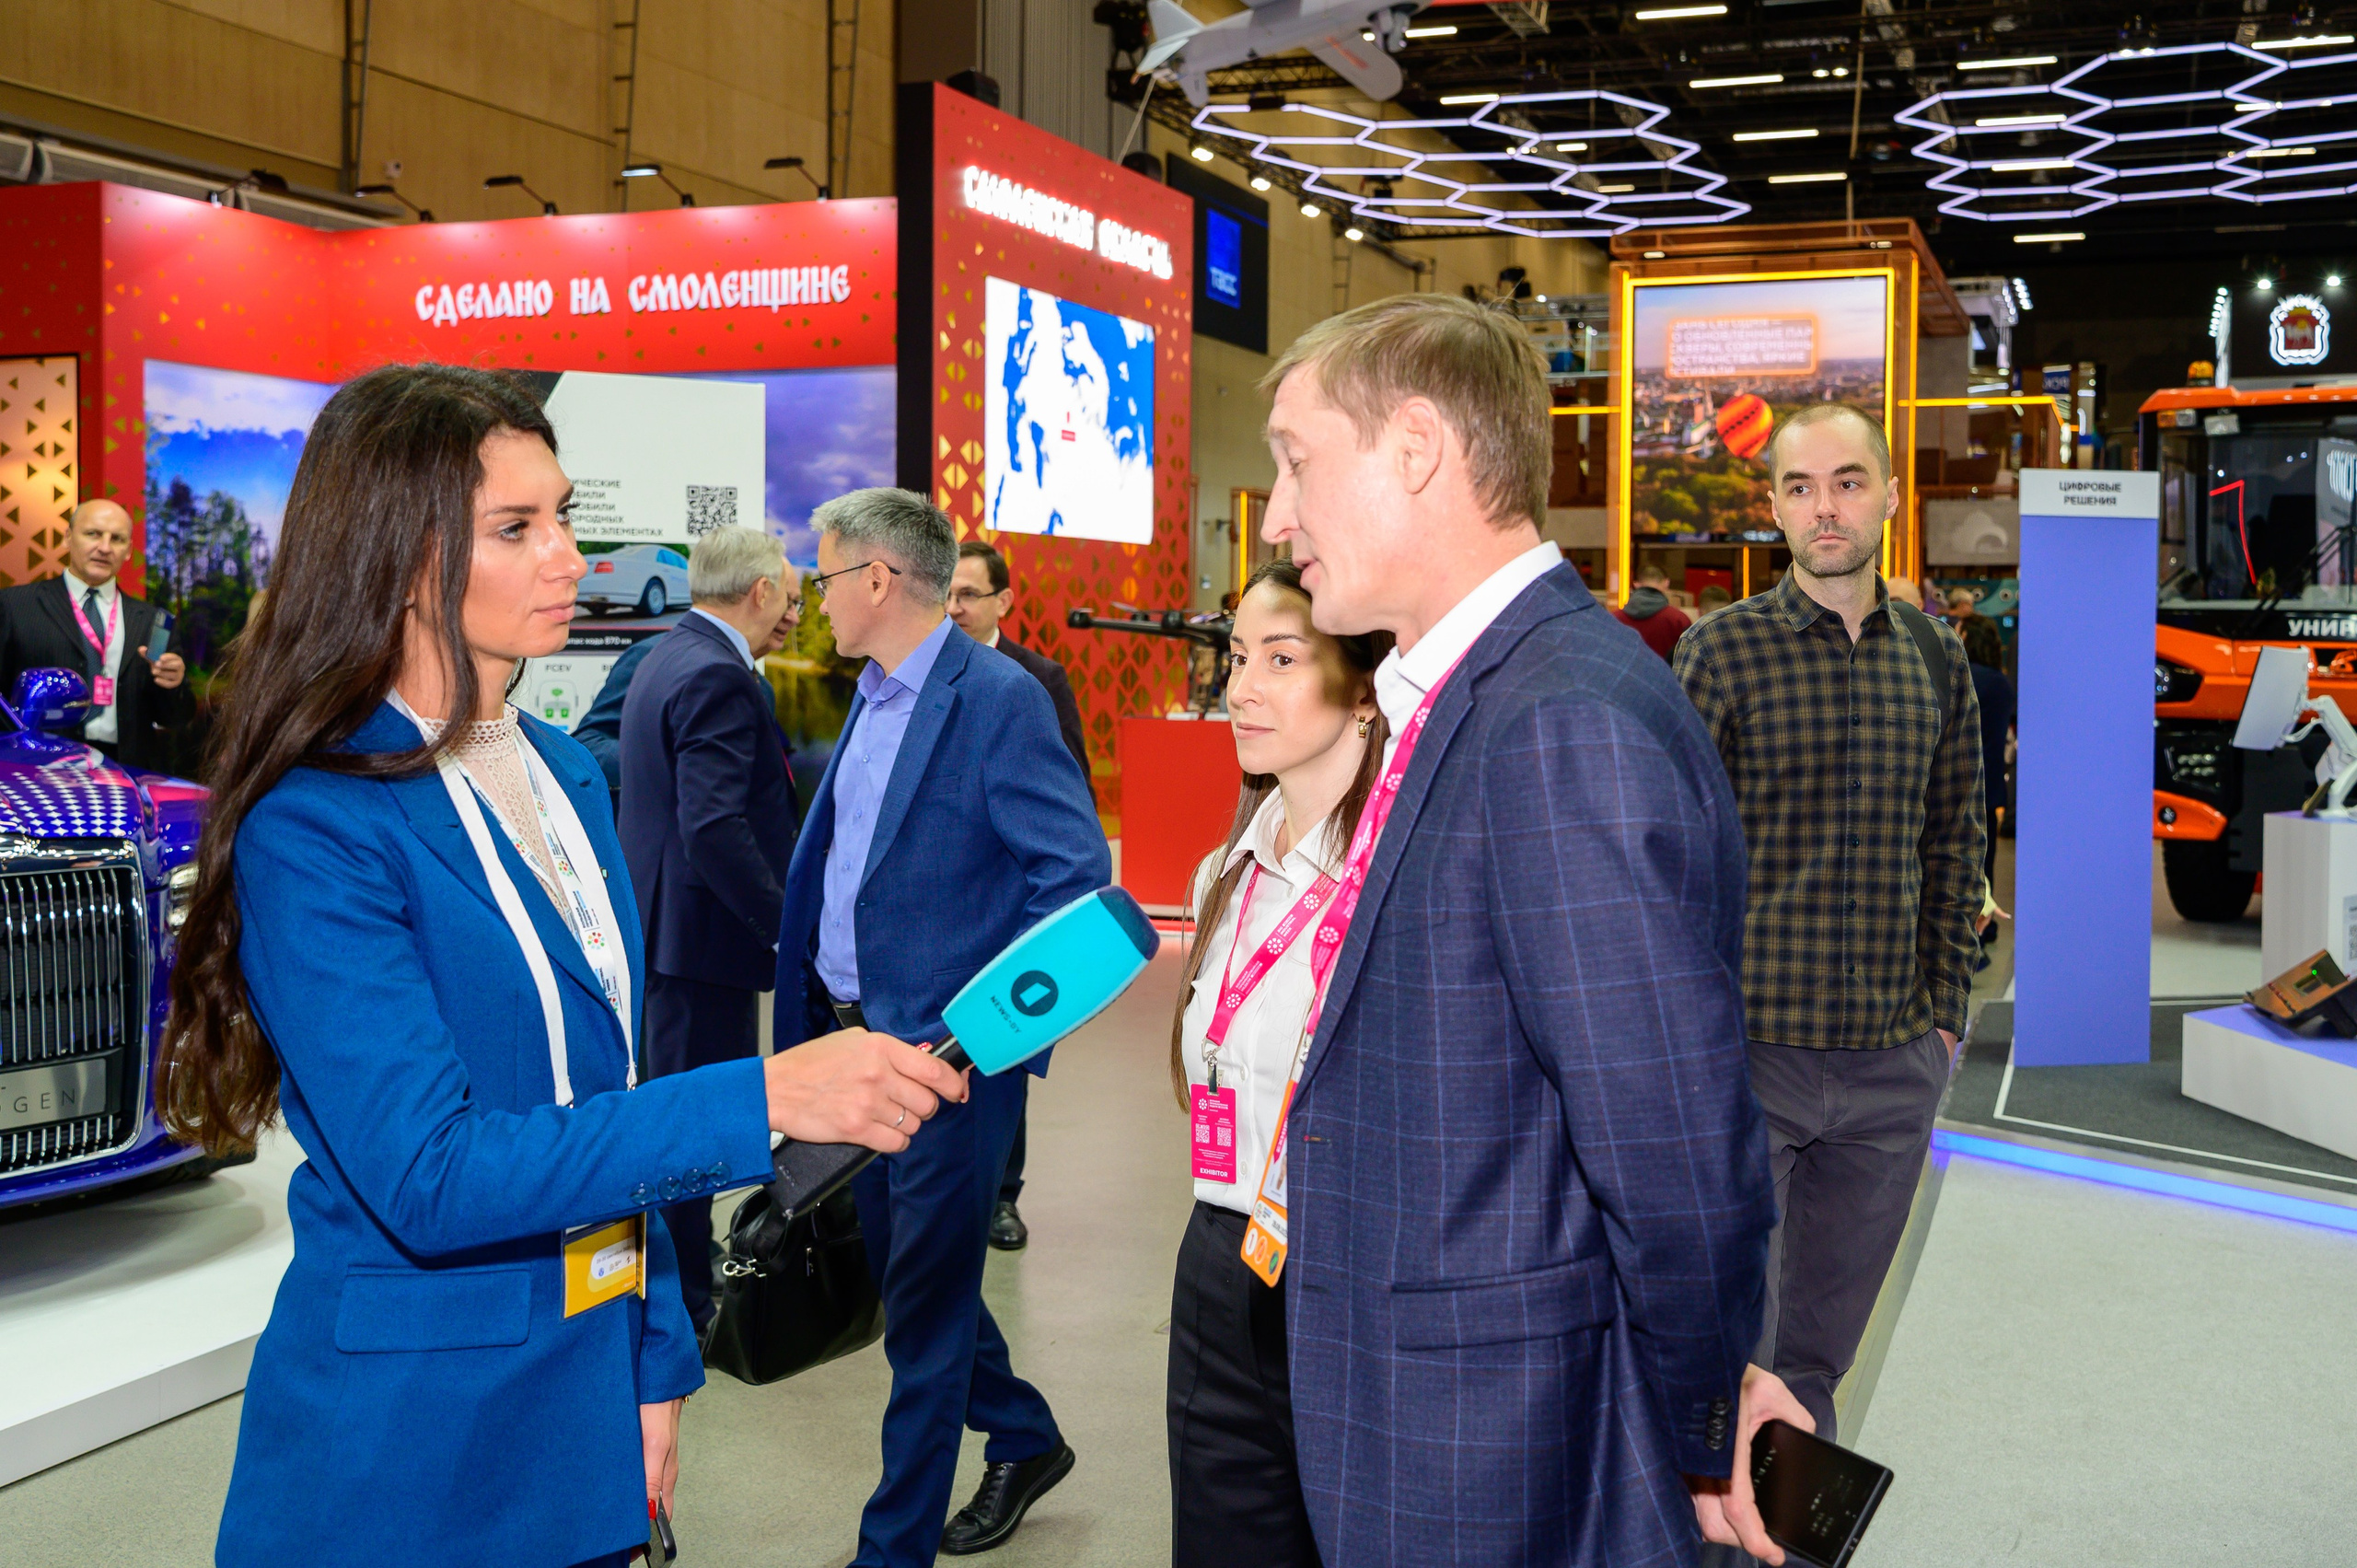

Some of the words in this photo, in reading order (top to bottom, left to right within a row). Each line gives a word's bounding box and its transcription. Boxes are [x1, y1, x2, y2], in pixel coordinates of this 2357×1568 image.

[414, 279, 554, 328] СДЕЛАНО
[569, 276, 611, 316] НА
[627, 264, 852, 314] СМОЛЕНЩИНЕ
[570, 479, 621, 488] ИЧЕСКИЕ
[2059, 481, 2122, 493] ЦИФРОВЫЕ
[2063, 495, 2117, 505] РЕШЕНИЯ
[0, 1087, 75, 1113] GEN
[1200, 1167, 1228, 1178] EXHIBITOR
